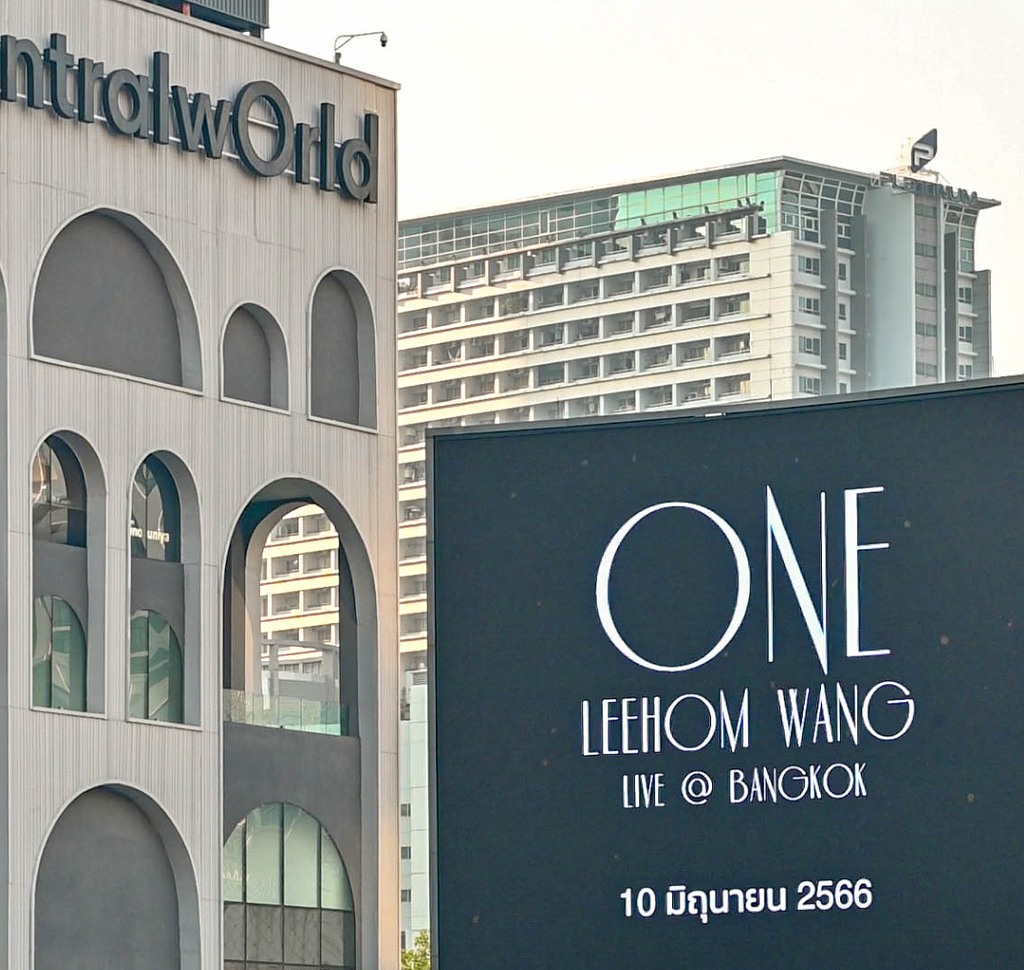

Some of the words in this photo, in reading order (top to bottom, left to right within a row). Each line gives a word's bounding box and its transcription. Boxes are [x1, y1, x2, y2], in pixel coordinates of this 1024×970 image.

[595, 484, 891, 676] ONE
[581, 687, 749, 756] LEEHOM
[776, 680, 915, 749] WANG
[622, 773, 666, 809] LIVE
[681, 770, 713, 805] @
[729, 762, 867, 804] BANGKOK
[620, 888, 656, 917] 10
[666, 885, 787, 924] มิถุนายน
[797, 879, 873, 911] 2566
